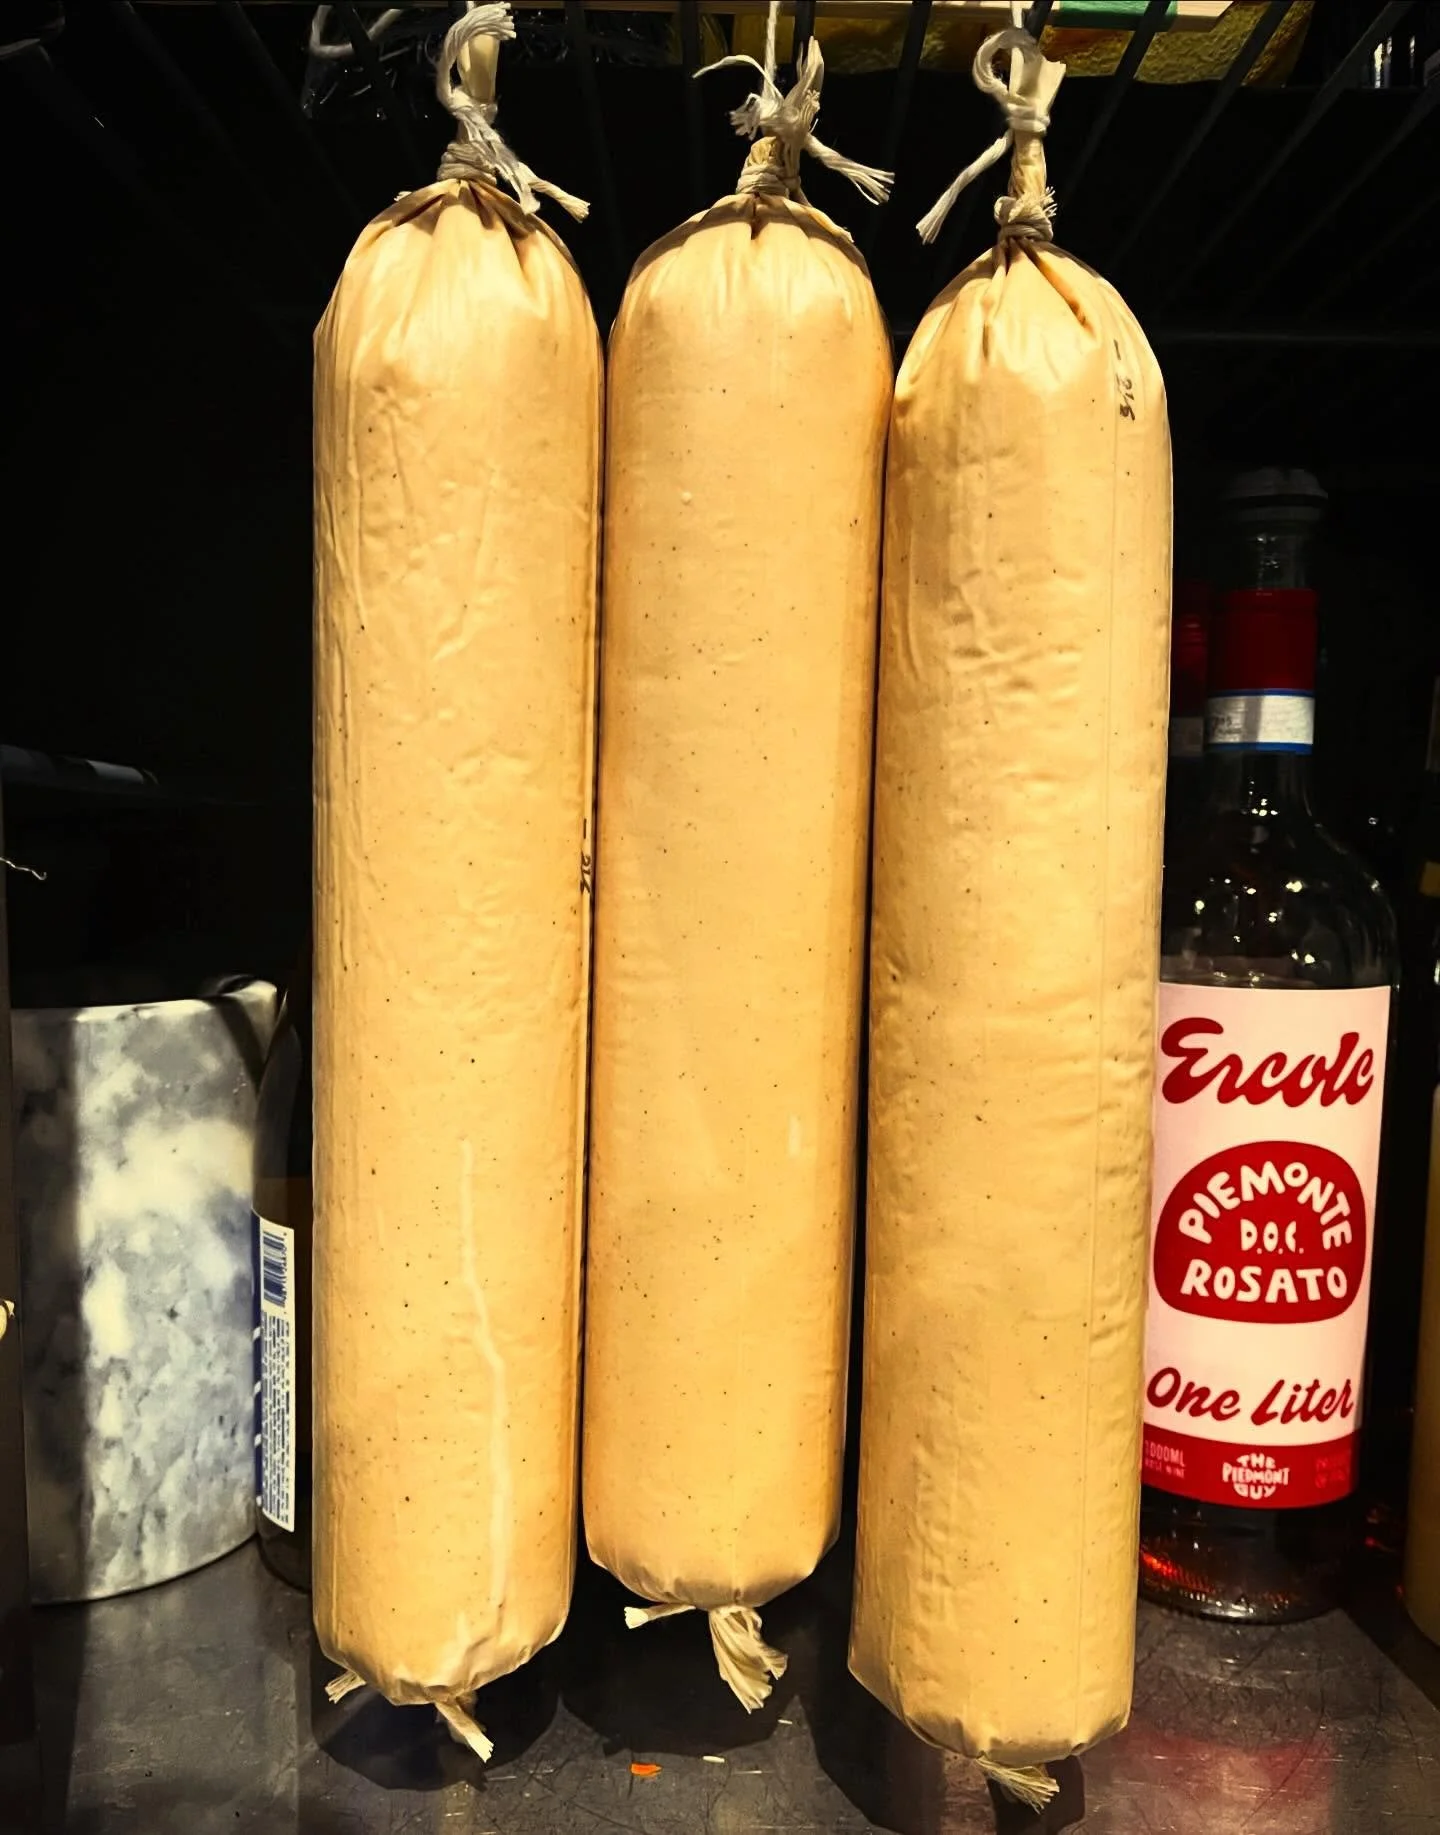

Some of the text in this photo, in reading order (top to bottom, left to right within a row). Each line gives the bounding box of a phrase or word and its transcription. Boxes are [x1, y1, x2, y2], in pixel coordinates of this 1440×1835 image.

[1160, 1016, 1375, 1108] Ercole
[1178, 1160, 1353, 1251] PIEMONTE
[1240, 1218, 1305, 1255] D.O.C.
[1180, 1258, 1348, 1304] ROSATO
[1146, 1366, 1356, 1426] One Liter
[1222, 1461, 1291, 1486] PIEDMONT
[1236, 1452, 1277, 1469] THE
[1233, 1482, 1277, 1500] GUY
